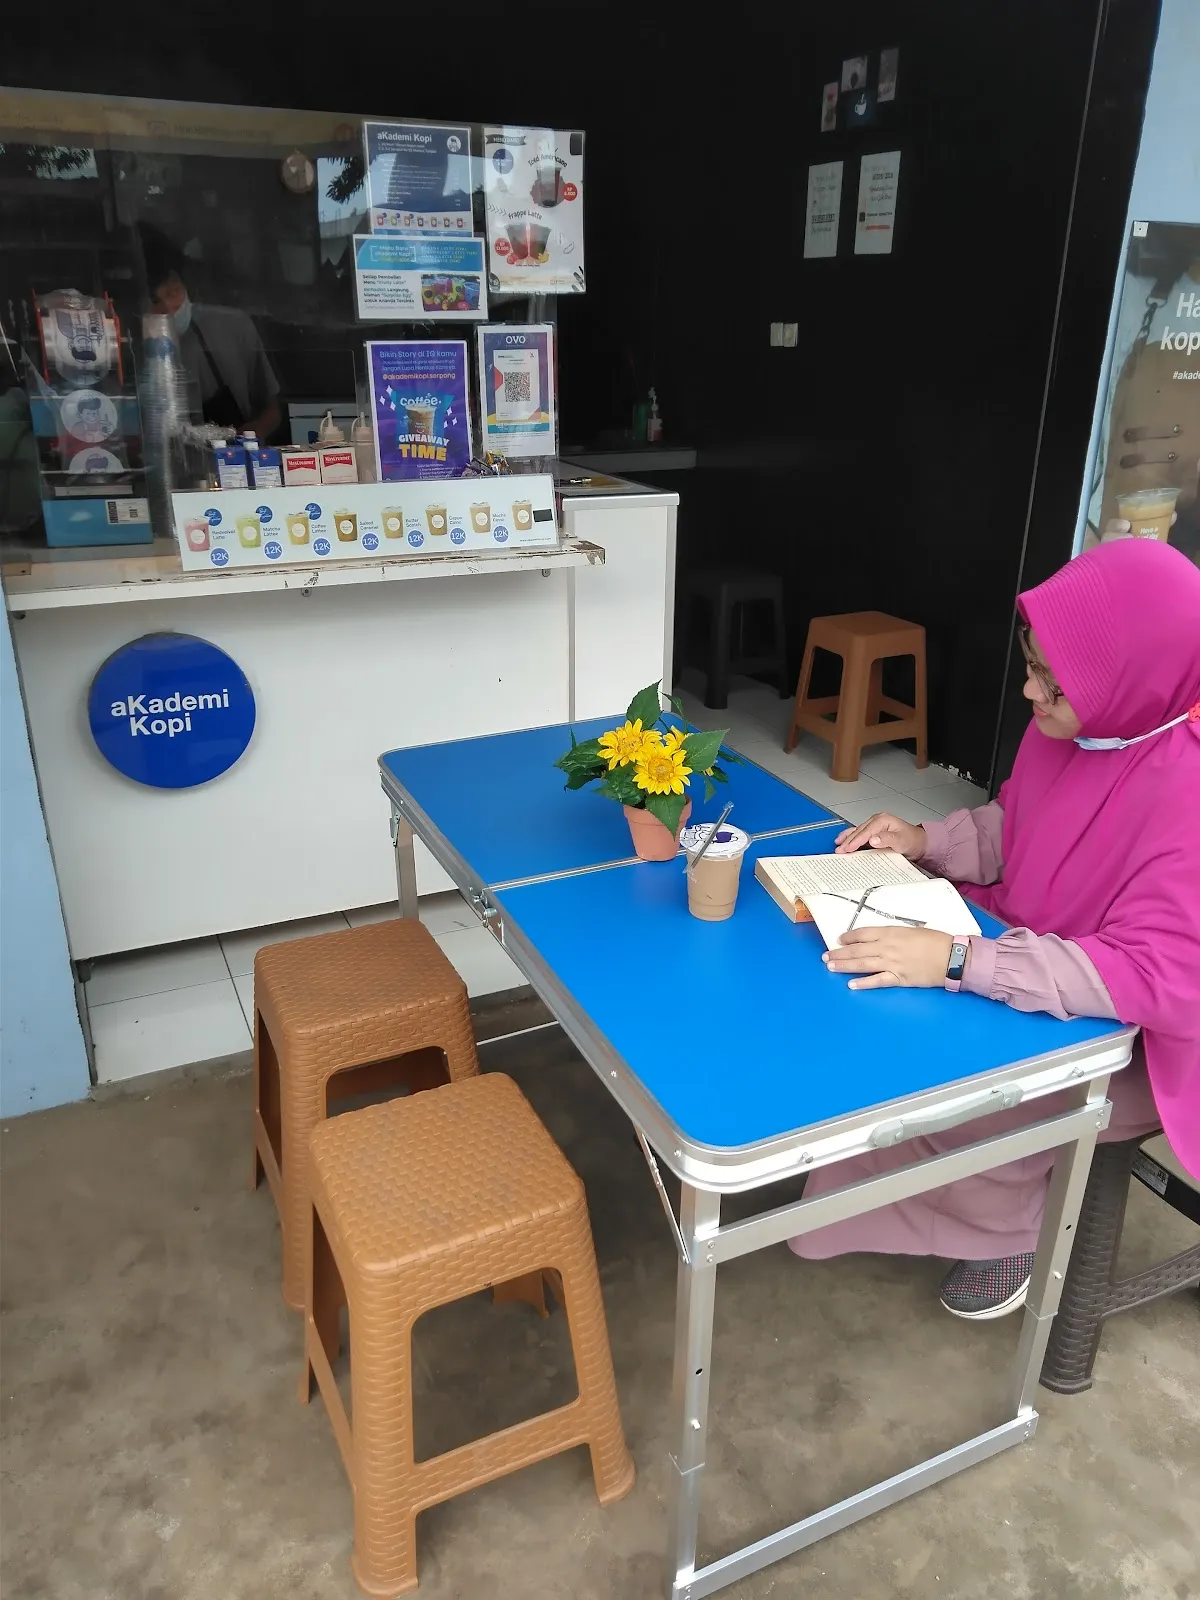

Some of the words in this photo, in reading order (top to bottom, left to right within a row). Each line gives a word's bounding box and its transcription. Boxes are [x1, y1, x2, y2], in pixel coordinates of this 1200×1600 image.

[377, 131, 412, 141] aKademi
[413, 133, 432, 144] Kopi
[505, 335, 526, 344] OVO
[397, 350, 417, 359] Story
[417, 350, 425, 358] di
[426, 350, 436, 358] IG
[398, 433, 450, 446] GIVEAWAY
[398, 443, 447, 462] TIME
[408, 534, 425, 543] 12K
[451, 532, 466, 540] 12K
[493, 530, 509, 538] 12K
[362, 537, 379, 546] 12K
[265, 546, 282, 555] 12K
[314, 542, 331, 551] 12K
[212, 552, 229, 561] 12K
[110, 688, 229, 717] aKademi
[130, 712, 192, 738] Kopi
